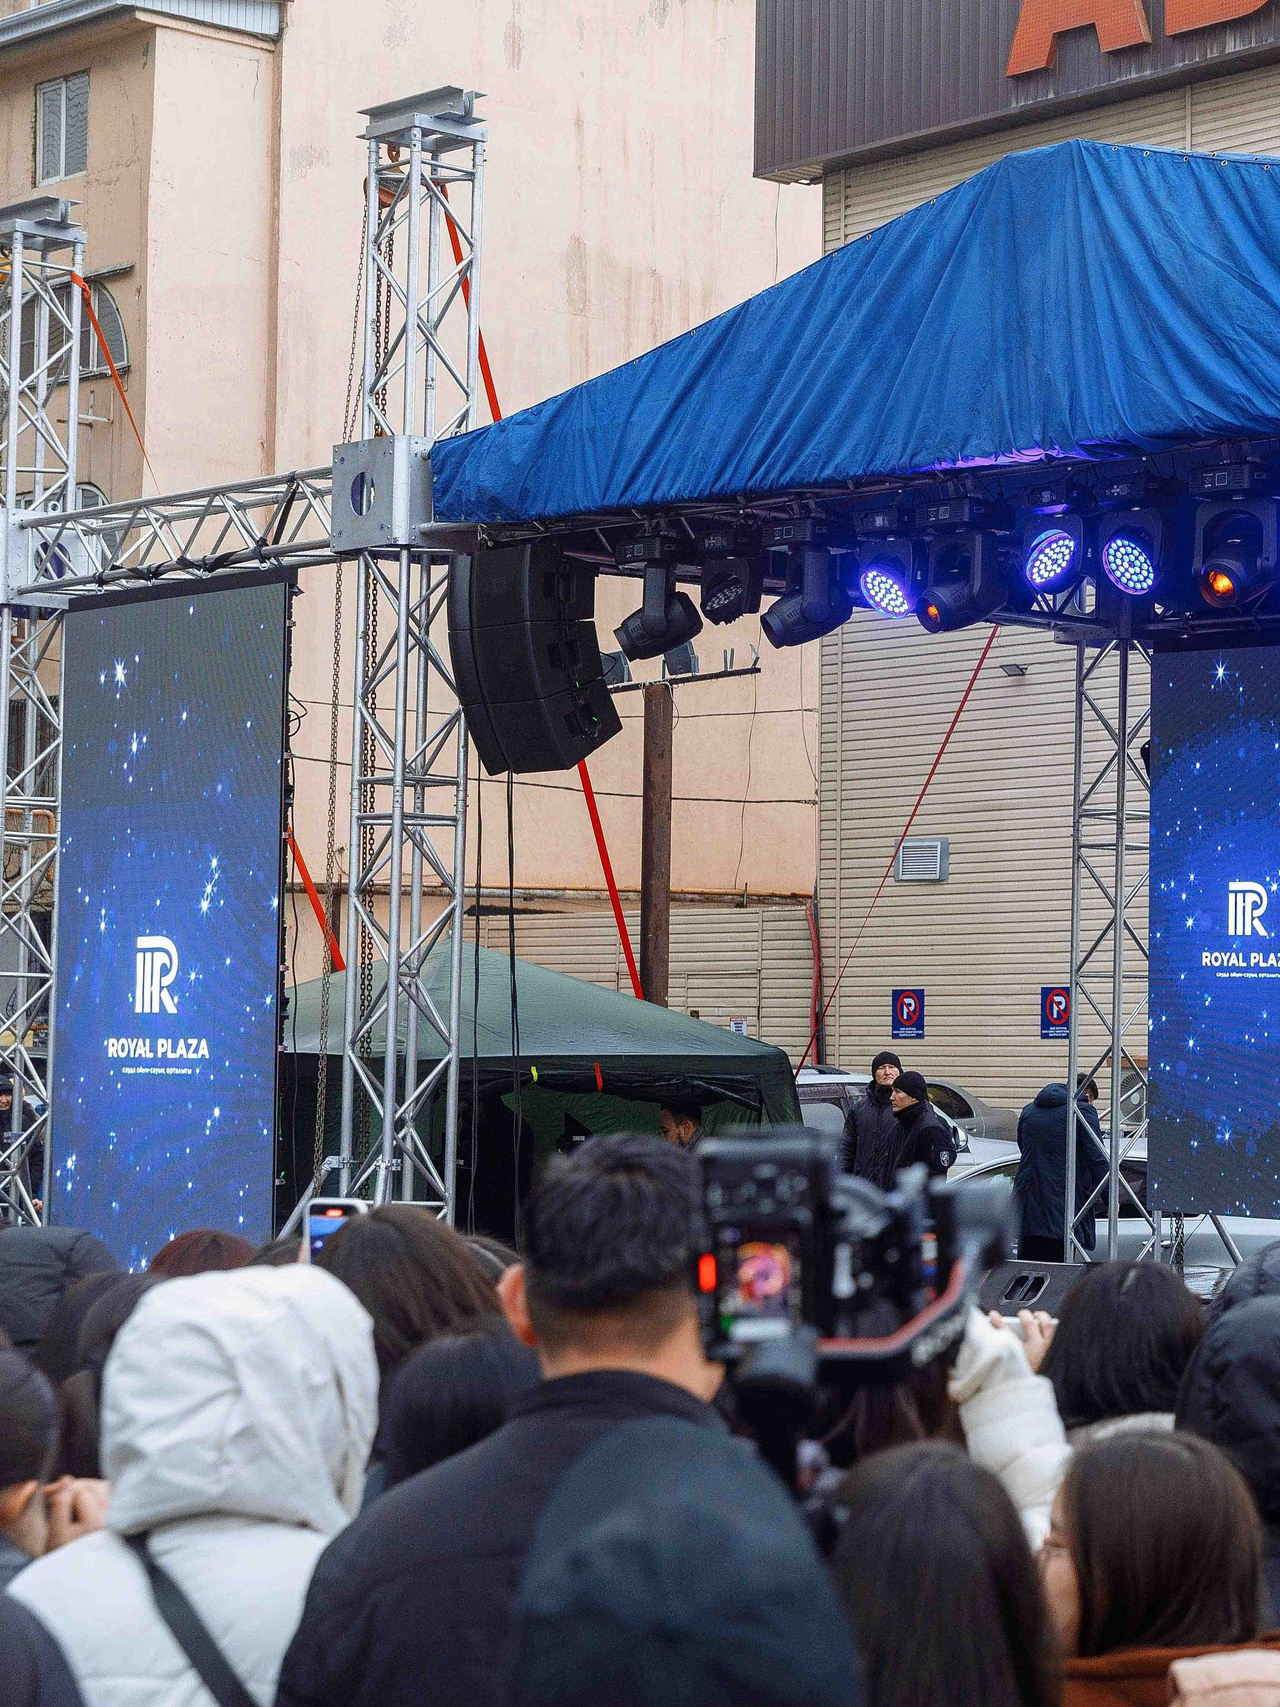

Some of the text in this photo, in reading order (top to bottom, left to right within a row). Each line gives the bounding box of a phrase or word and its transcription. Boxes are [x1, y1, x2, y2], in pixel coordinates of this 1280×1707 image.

[1202, 952, 1247, 967] ROYAL
[903, 998, 915, 1020] P
[1053, 996, 1066, 1018] P
[107, 1038, 210, 1059] ROYAL PLAZA
